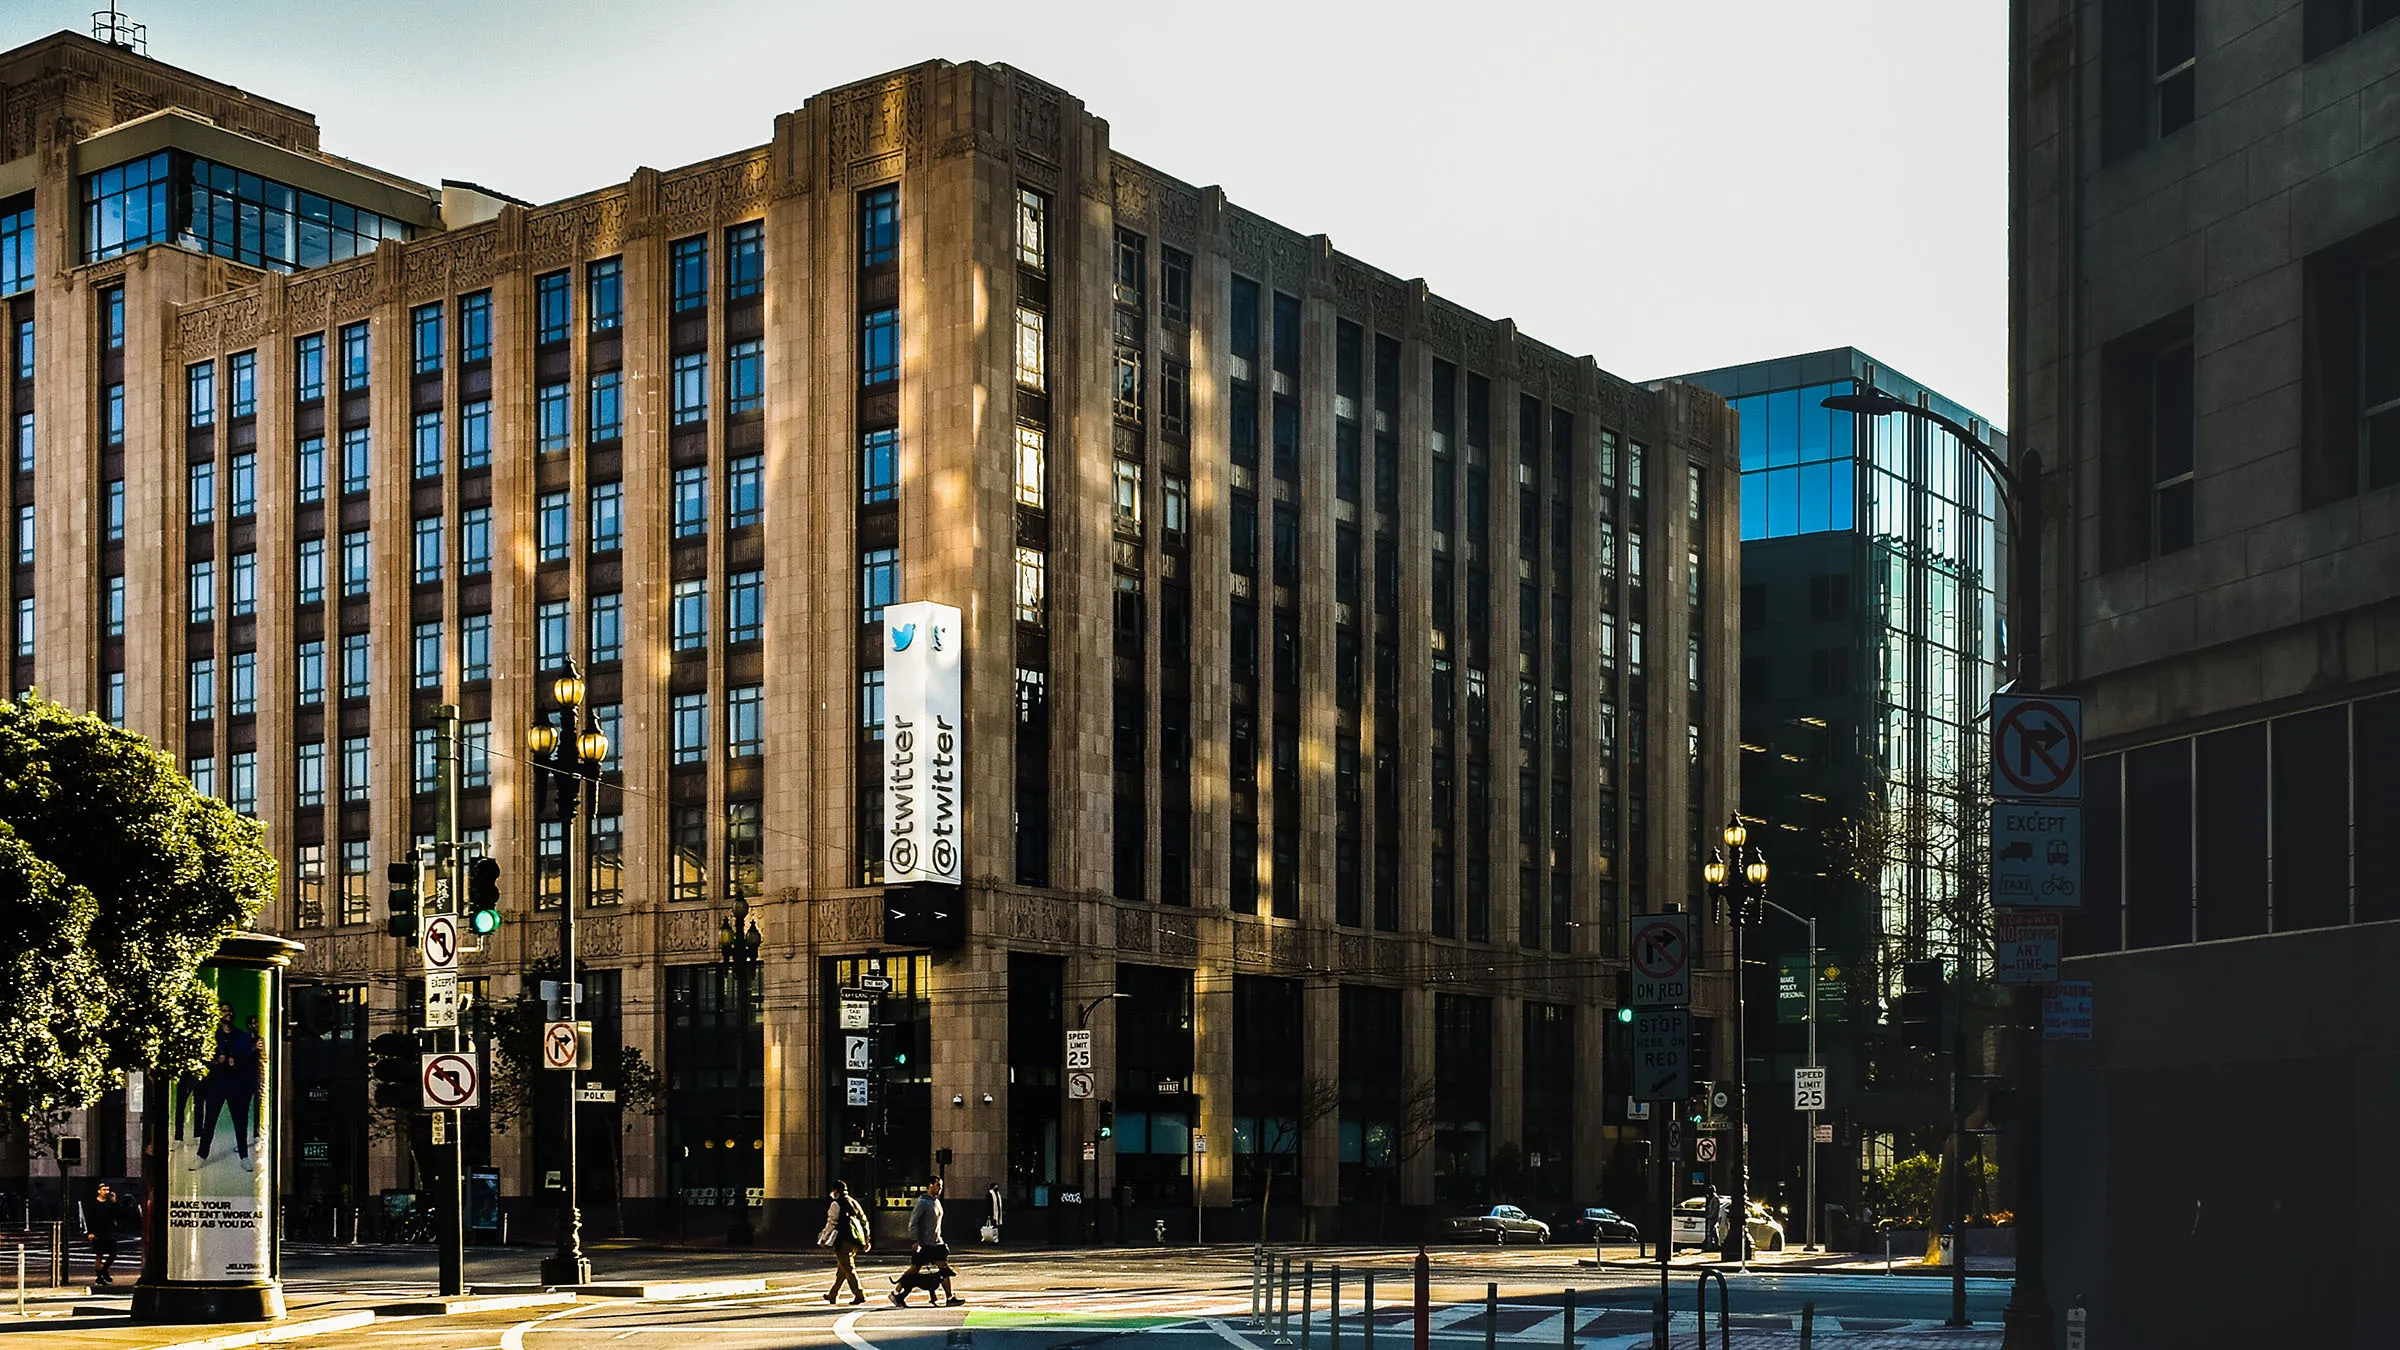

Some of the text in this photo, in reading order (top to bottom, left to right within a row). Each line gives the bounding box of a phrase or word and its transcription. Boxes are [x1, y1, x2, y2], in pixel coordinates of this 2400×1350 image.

[889, 714, 918, 875] @twitter
[931, 714, 958, 876] @twitter
[2006, 815, 2066, 832] EXCEPT
[2003, 879, 2028, 890] TAXI
[2000, 926, 2015, 941] NO
[2016, 945, 2041, 956] ANY
[2016, 959, 2042, 970] TIME
[431, 977, 455, 987] EXCEPT
[1637, 982, 1683, 998] ON RED
[1639, 1018, 1682, 1033] STOP
[1637, 1037, 1685, 1048] HERE ON
[1068, 1051, 1089, 1066] 25
[1645, 1052, 1678, 1067] RED
[1797, 1071, 1823, 1079] SPEED
[1158, 1083, 1179, 1092] MARKET
[1799, 1081, 1821, 1089] LIMIT
[584, 1091, 605, 1100] POLK
[1797, 1091, 1823, 1106] 25
[303, 1145, 328, 1157] MARKET
[170, 1201, 231, 1210] MAKE YOUR
[169, 1210, 263, 1219] CONTENT WORK AS
[169, 1220, 256, 1229] HARD AS YOU DO.
